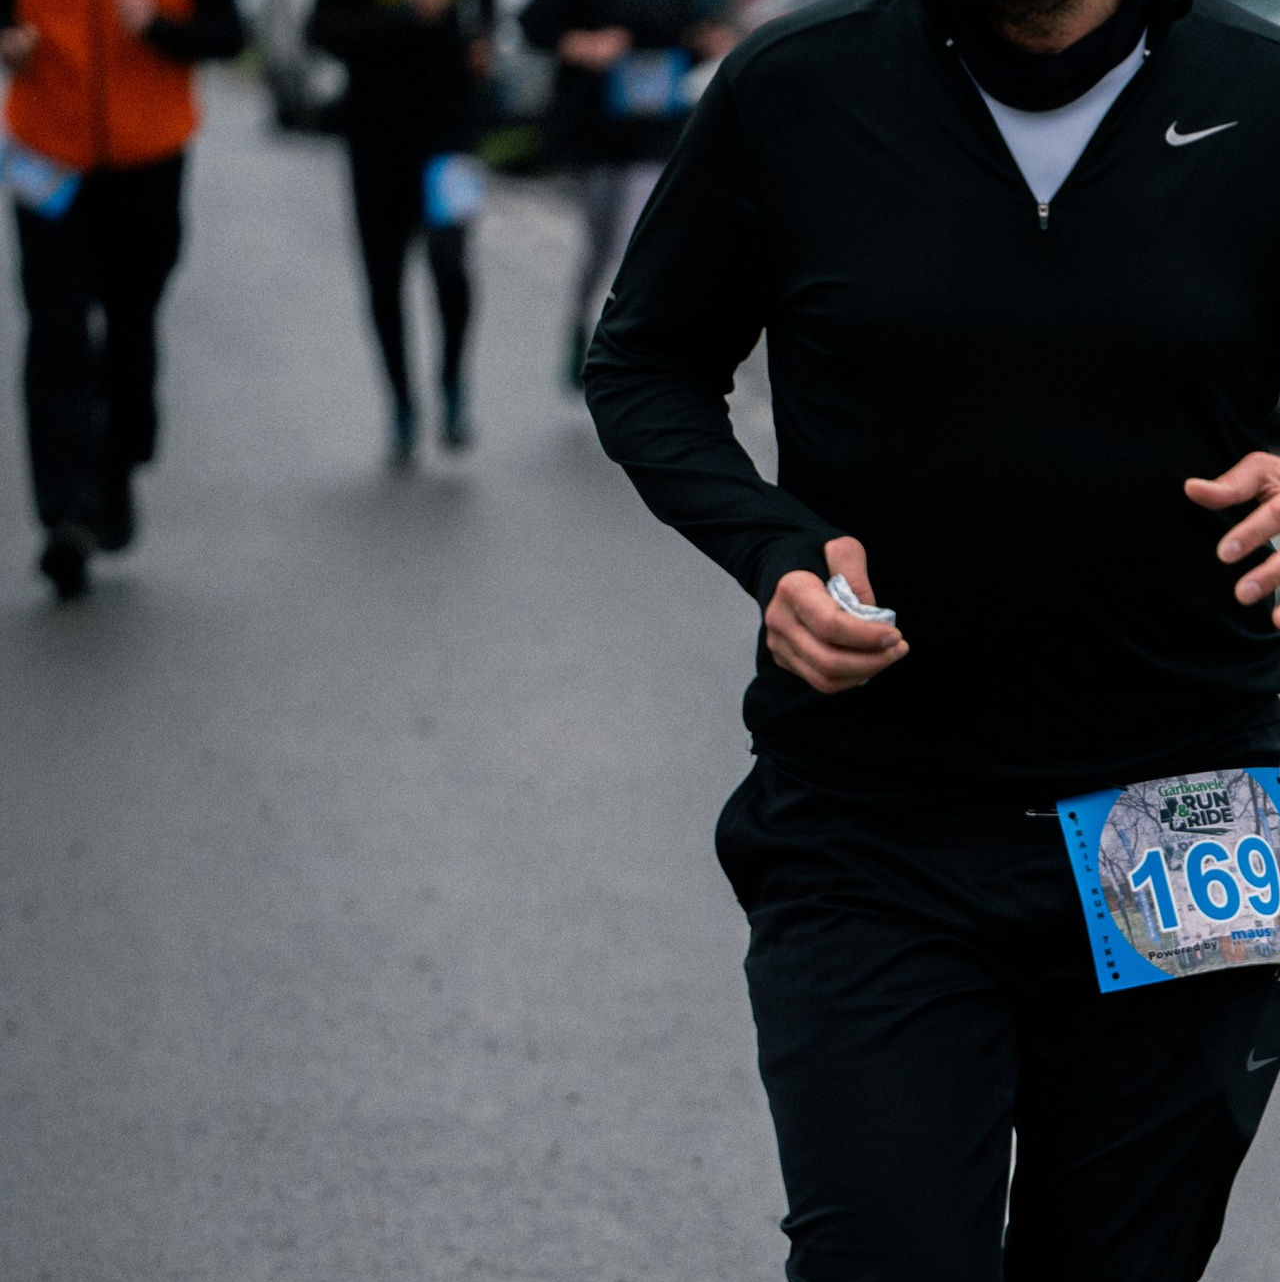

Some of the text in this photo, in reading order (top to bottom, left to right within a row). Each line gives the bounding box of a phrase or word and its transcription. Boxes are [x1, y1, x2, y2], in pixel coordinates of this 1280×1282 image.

[1181, 790, 1231, 811] RUN
[1178, 803, 1235, 828] & RIDE
[1092, 888, 1105, 920] RUN
[1231, 927, 1272, 940] maus
[1148, 943, 1200, 960] Powered
[1204, 940, 1218, 951] by
